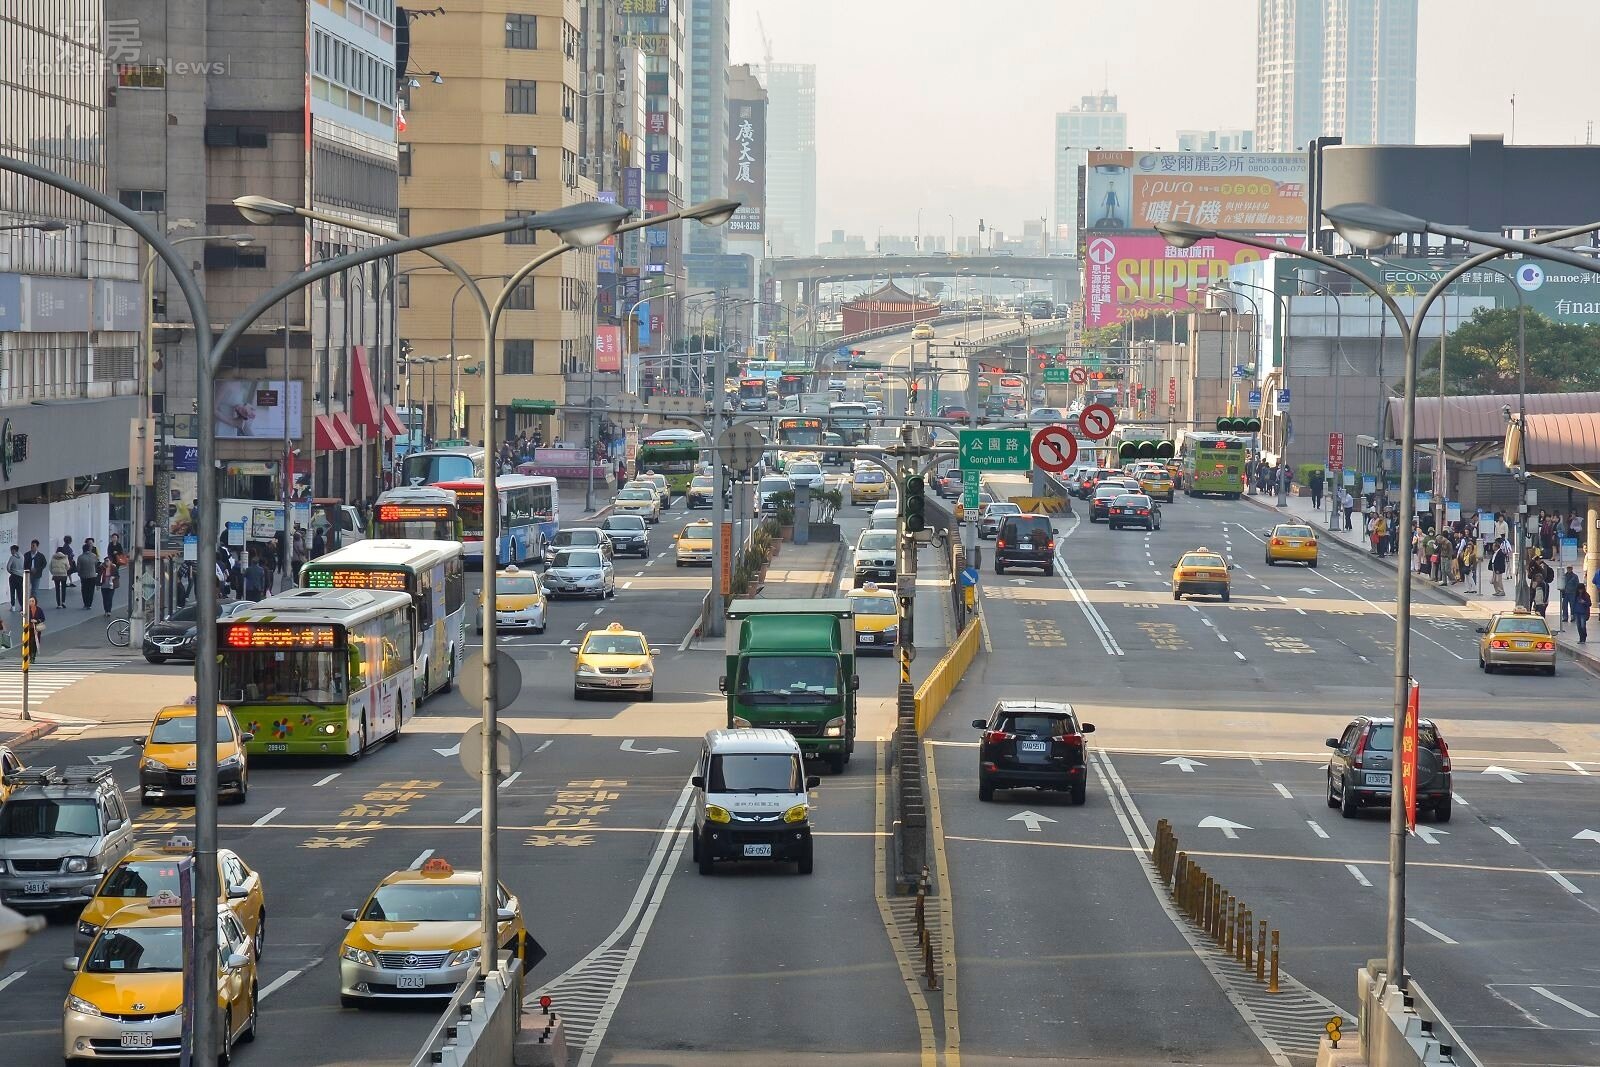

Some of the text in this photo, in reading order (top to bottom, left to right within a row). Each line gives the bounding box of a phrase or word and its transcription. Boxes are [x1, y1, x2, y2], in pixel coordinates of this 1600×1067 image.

[651, 115, 665, 132] 學
[1160, 155, 1244, 173] 愛爾麗診所
[1151, 181, 1194, 197] pura
[1145, 200, 1222, 224] 曬白機
[1165, 246, 1215, 258] 超級城市
[1461, 272, 1505, 283] 智慧節能
[970, 437, 1018, 451] 公園路
[969, 456, 1005, 465] GongYuan
